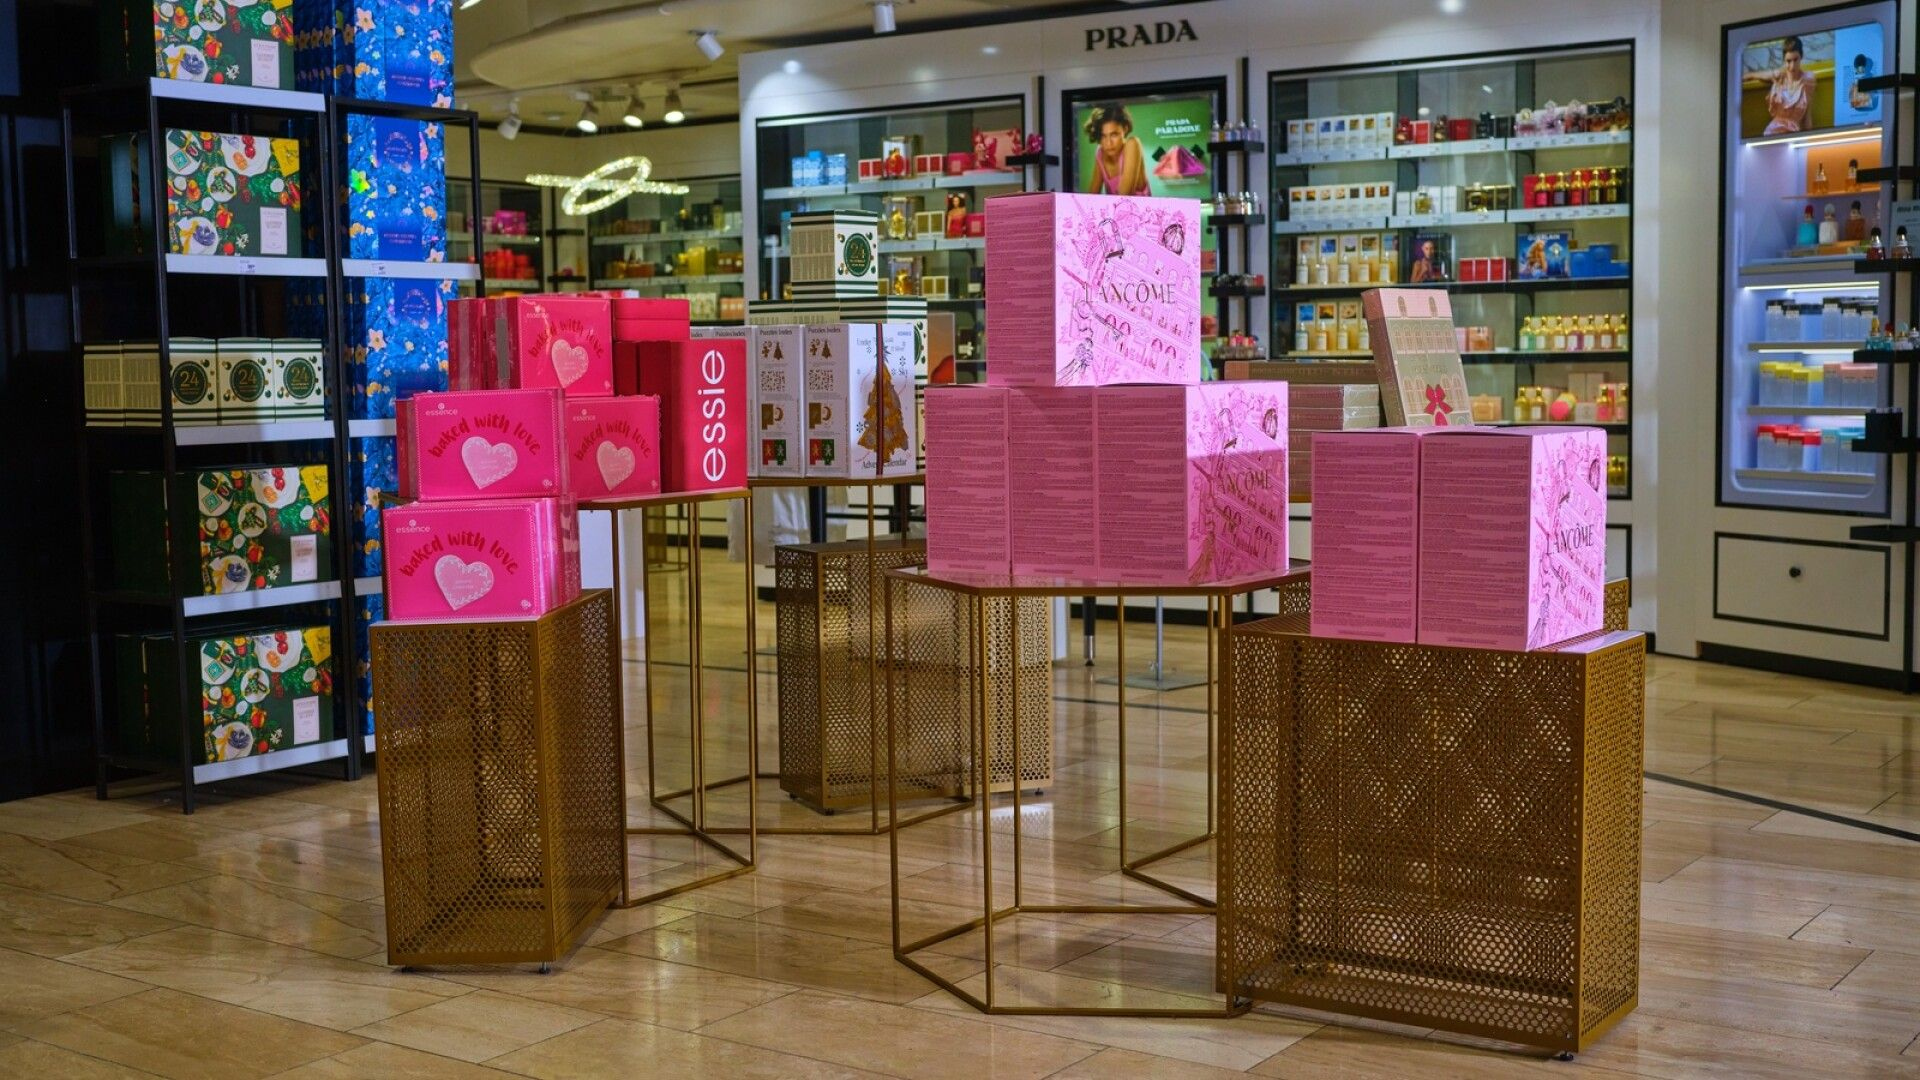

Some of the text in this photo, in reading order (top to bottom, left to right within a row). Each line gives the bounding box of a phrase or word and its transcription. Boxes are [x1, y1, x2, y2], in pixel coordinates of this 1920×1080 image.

[1085, 19, 1198, 51] PRADA
[1165, 118, 1190, 127] PRADA
[1085, 279, 1177, 304] LANCÔME
[559, 319, 584, 338] with
[180, 370, 199, 385] 24
[239, 368, 256, 385] 24
[291, 366, 308, 382] 24
[425, 408, 458, 416] essence
[697, 349, 727, 482] essie
[427, 413, 541, 458] baked with love
[574, 419, 652, 461] baked with love
[395, 525, 431, 534] essence
[398, 530, 519, 577] baked with love
